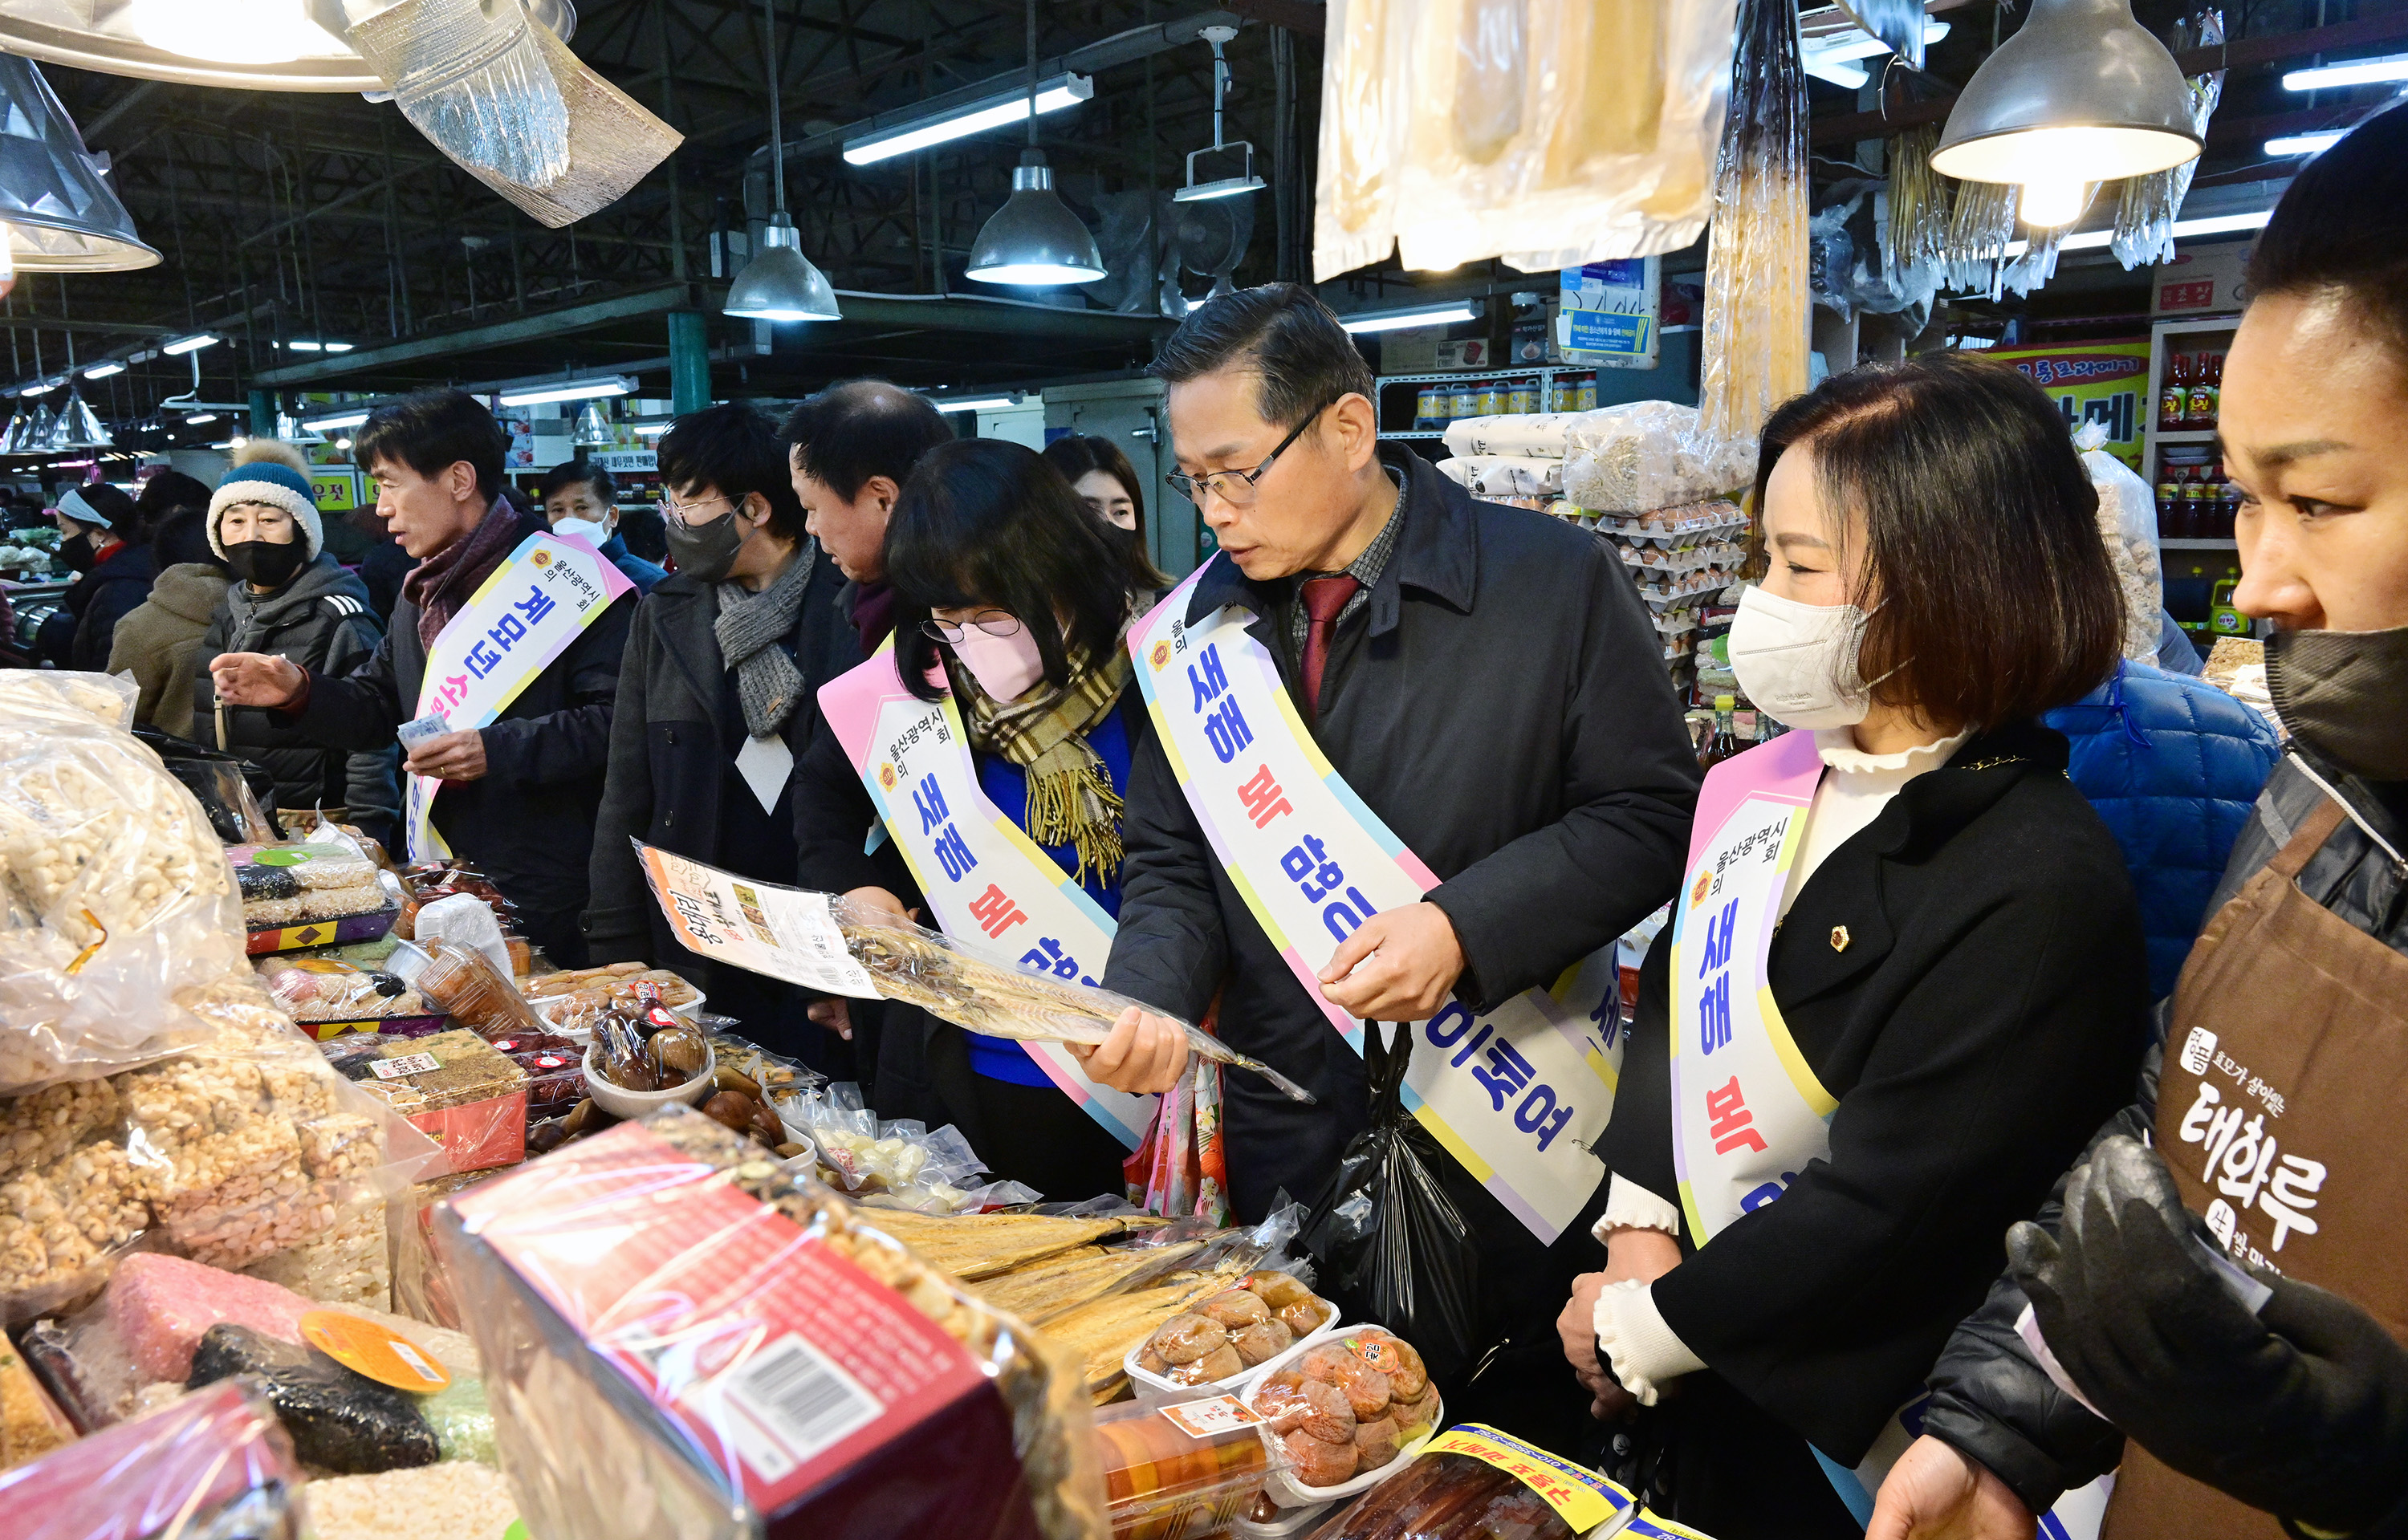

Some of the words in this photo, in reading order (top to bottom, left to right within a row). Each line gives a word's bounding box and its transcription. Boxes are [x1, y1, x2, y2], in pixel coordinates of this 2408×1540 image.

[311, 484, 344, 502] 우젓
[555, 559, 600, 603] 울산광역시
[463, 584, 556, 681] 계묘년
[889, 707, 944, 762] 울산광역시
[912, 771, 978, 883] 새해
[968, 883, 1029, 939] 복
[1715, 816, 1788, 873] 울산광역시
[669, 889, 724, 945] 용대리
[1186, 641, 1255, 765] 새해
[1237, 763, 1295, 830] 복
[1426, 1000, 1574, 1152] 으세요
[1698, 896, 1740, 1057] 새해
[2189, 1028, 2213, 1075] 명품
[2213, 1049, 2248, 1087] 효모가
[2248, 1075, 2288, 1117] 살아있는
[1706, 1075, 1769, 1156] 복
[2180, 1082, 2326, 1252] 태화루
[2233, 1230, 2250, 1259] 쌀
[1441, 1439, 1509, 1464] 과메기
[1507, 1462, 1572, 1506] 구룡포
